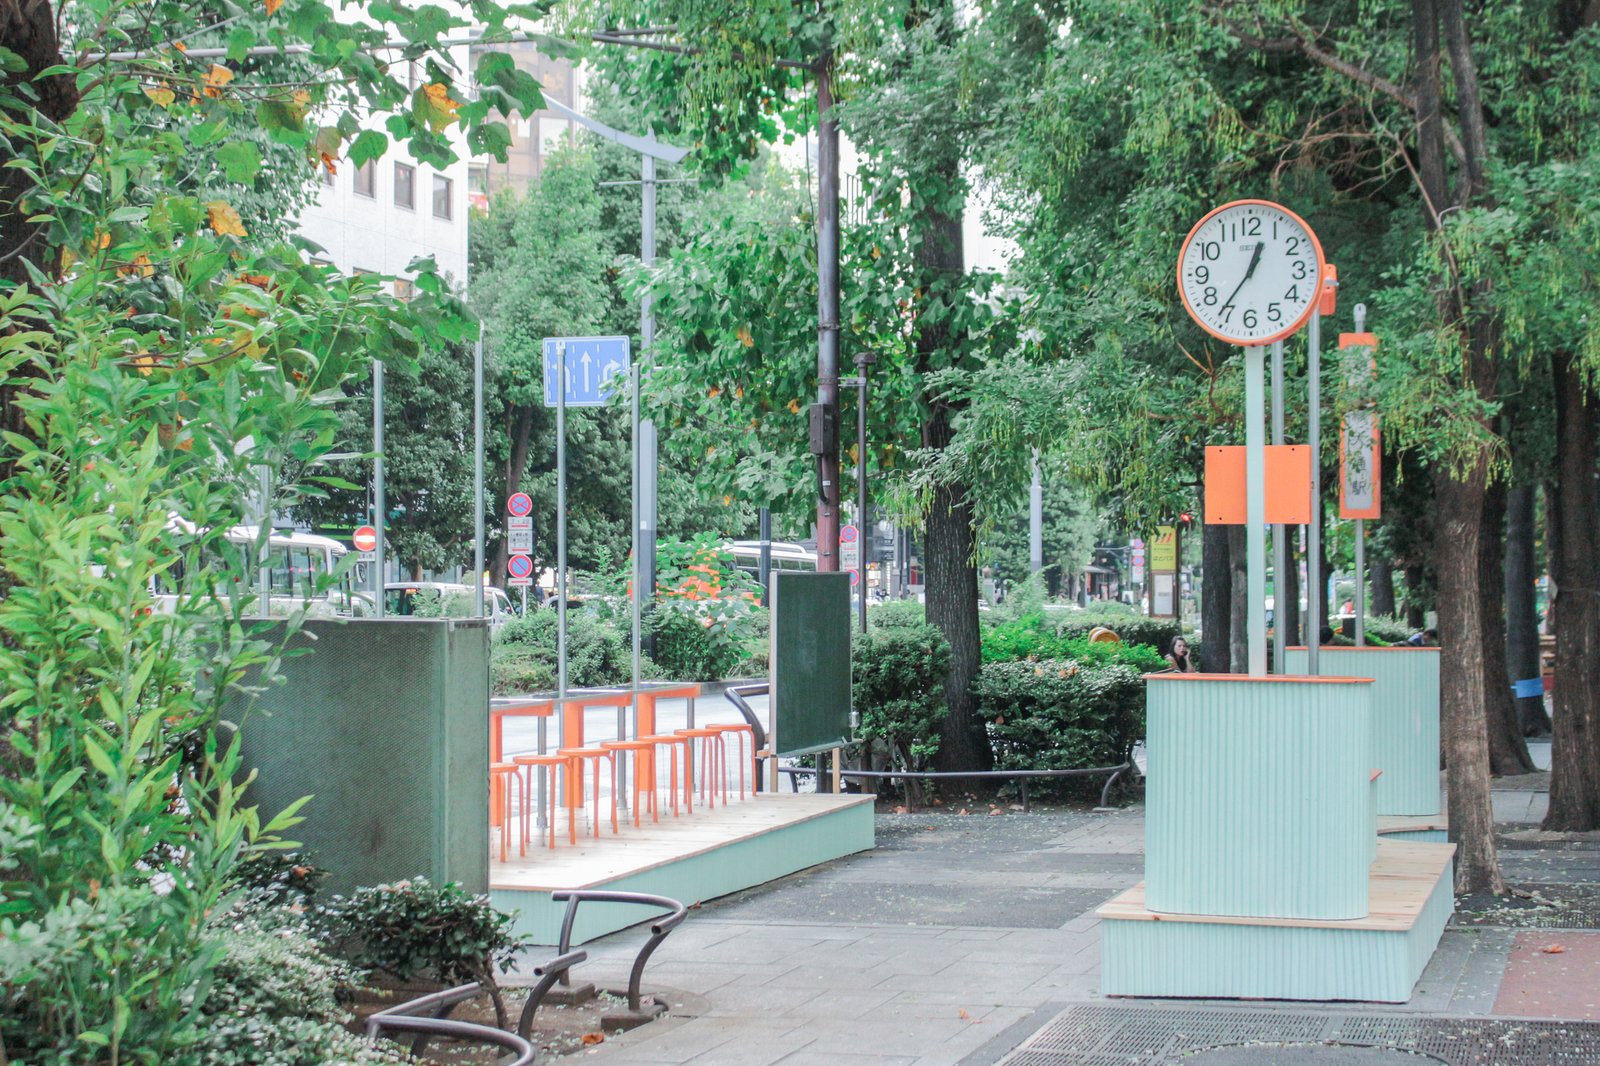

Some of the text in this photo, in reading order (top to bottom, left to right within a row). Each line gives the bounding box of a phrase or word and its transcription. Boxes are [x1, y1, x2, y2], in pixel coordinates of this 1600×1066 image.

[1221, 223, 1236, 242] 11
[1242, 217, 1262, 236] 12
[1273, 221, 1277, 240] 1
[1201, 241, 1221, 261] 10
[1285, 236, 1299, 256] 2
[1195, 265, 1209, 285] 9
[1291, 260, 1306, 280] 3
[1203, 286, 1218, 306] 8
[1284, 284, 1299, 303] 4
[1222, 304, 1236, 323] 7
[1243, 309, 1258, 329] 6
[1267, 302, 1281, 322] 5
